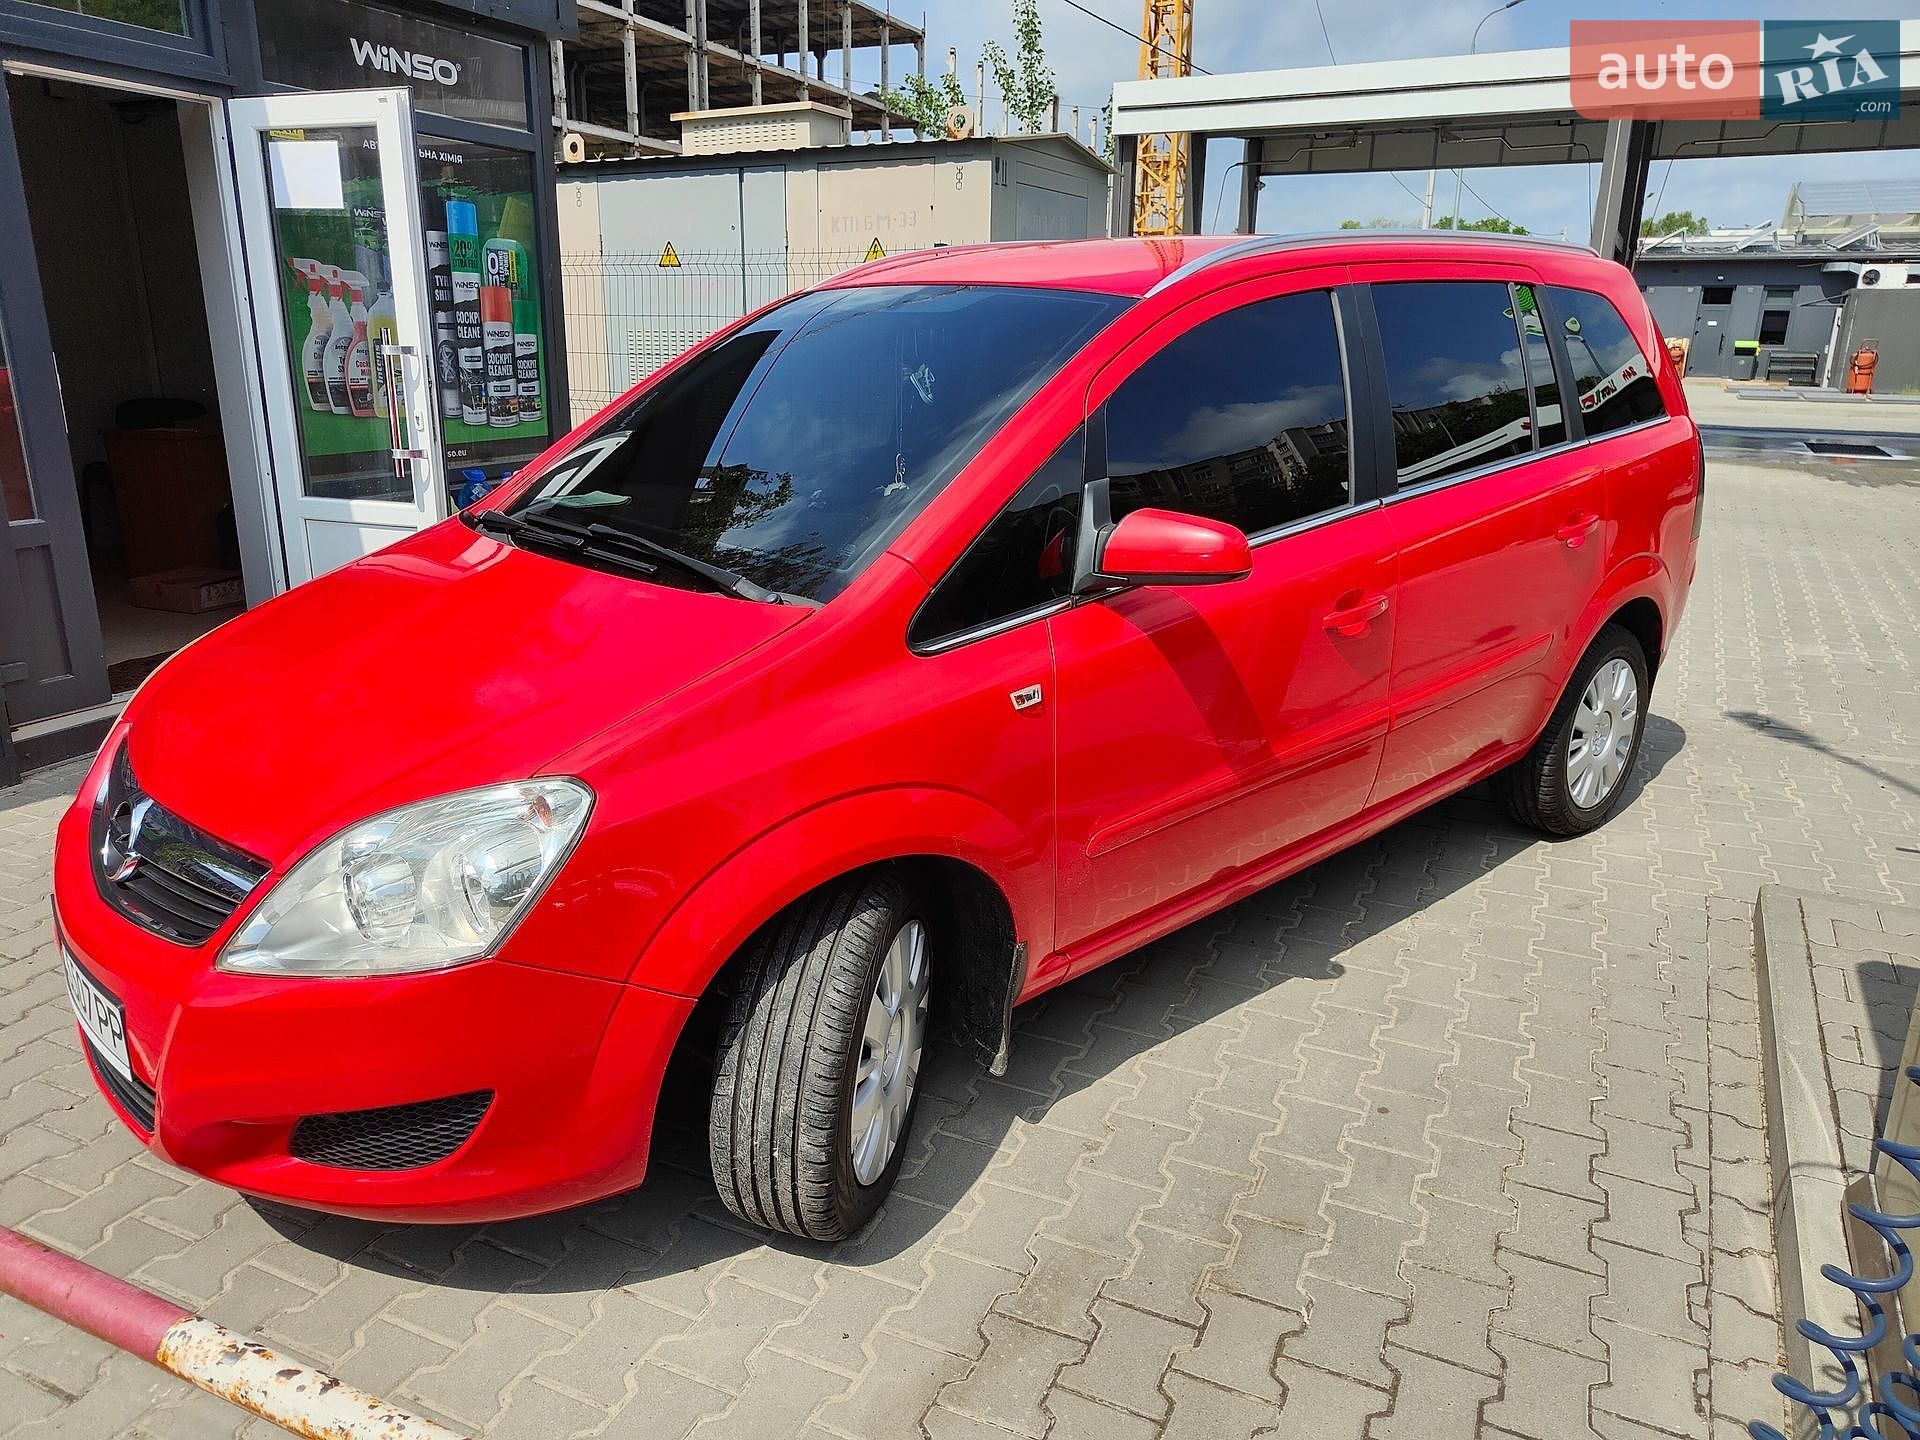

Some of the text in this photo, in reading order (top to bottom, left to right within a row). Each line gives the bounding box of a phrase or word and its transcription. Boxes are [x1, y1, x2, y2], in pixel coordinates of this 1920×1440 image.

[457, 325, 481, 338] CLEANE
[487, 352, 512, 365] COCKPIT
[517, 359, 537, 370] COCKPIT
[488, 364, 514, 376] CLEANER
[518, 369, 538, 379] CLEANER
